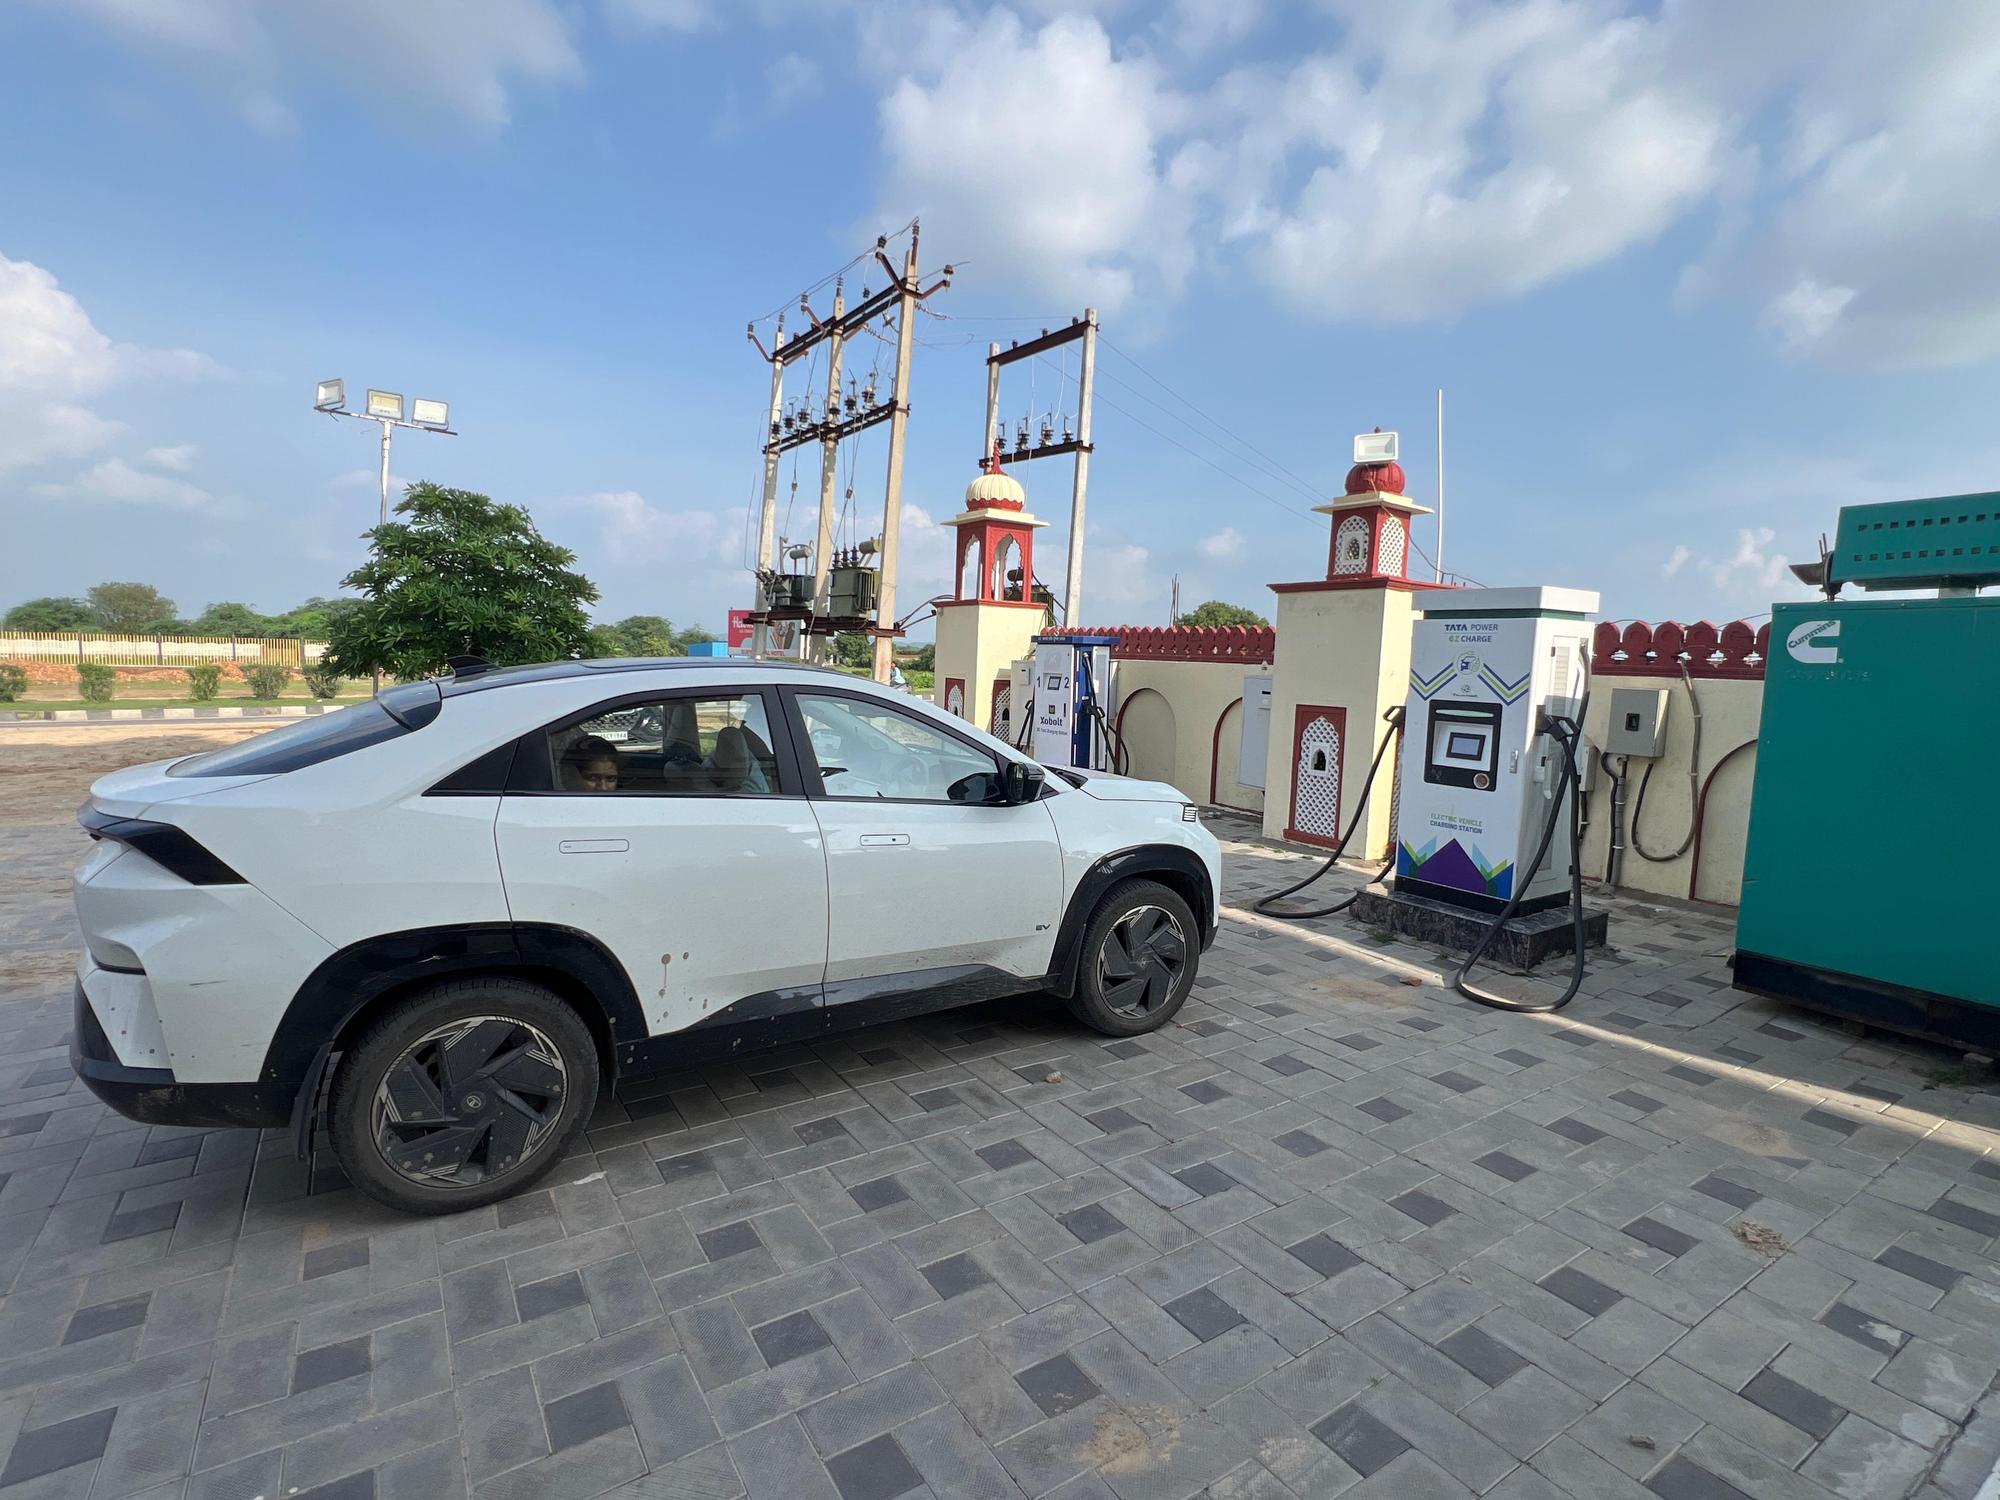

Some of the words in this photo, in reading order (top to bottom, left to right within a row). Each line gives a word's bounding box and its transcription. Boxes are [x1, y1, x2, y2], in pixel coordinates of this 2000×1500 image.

[1460, 635, 1493, 643] CHARGE
[1788, 621, 1836, 648] Cummins
[1036, 676, 1041, 688] 1
[1064, 676, 1070, 689] 2
[1040, 716, 1063, 727] Xobolt
[1430, 813, 1457, 822] ELECTRIC
[1458, 817, 1483, 827] VEHICLE
[1429, 820, 1458, 830] CHARGING
[1458, 825, 1483, 834] STATION
